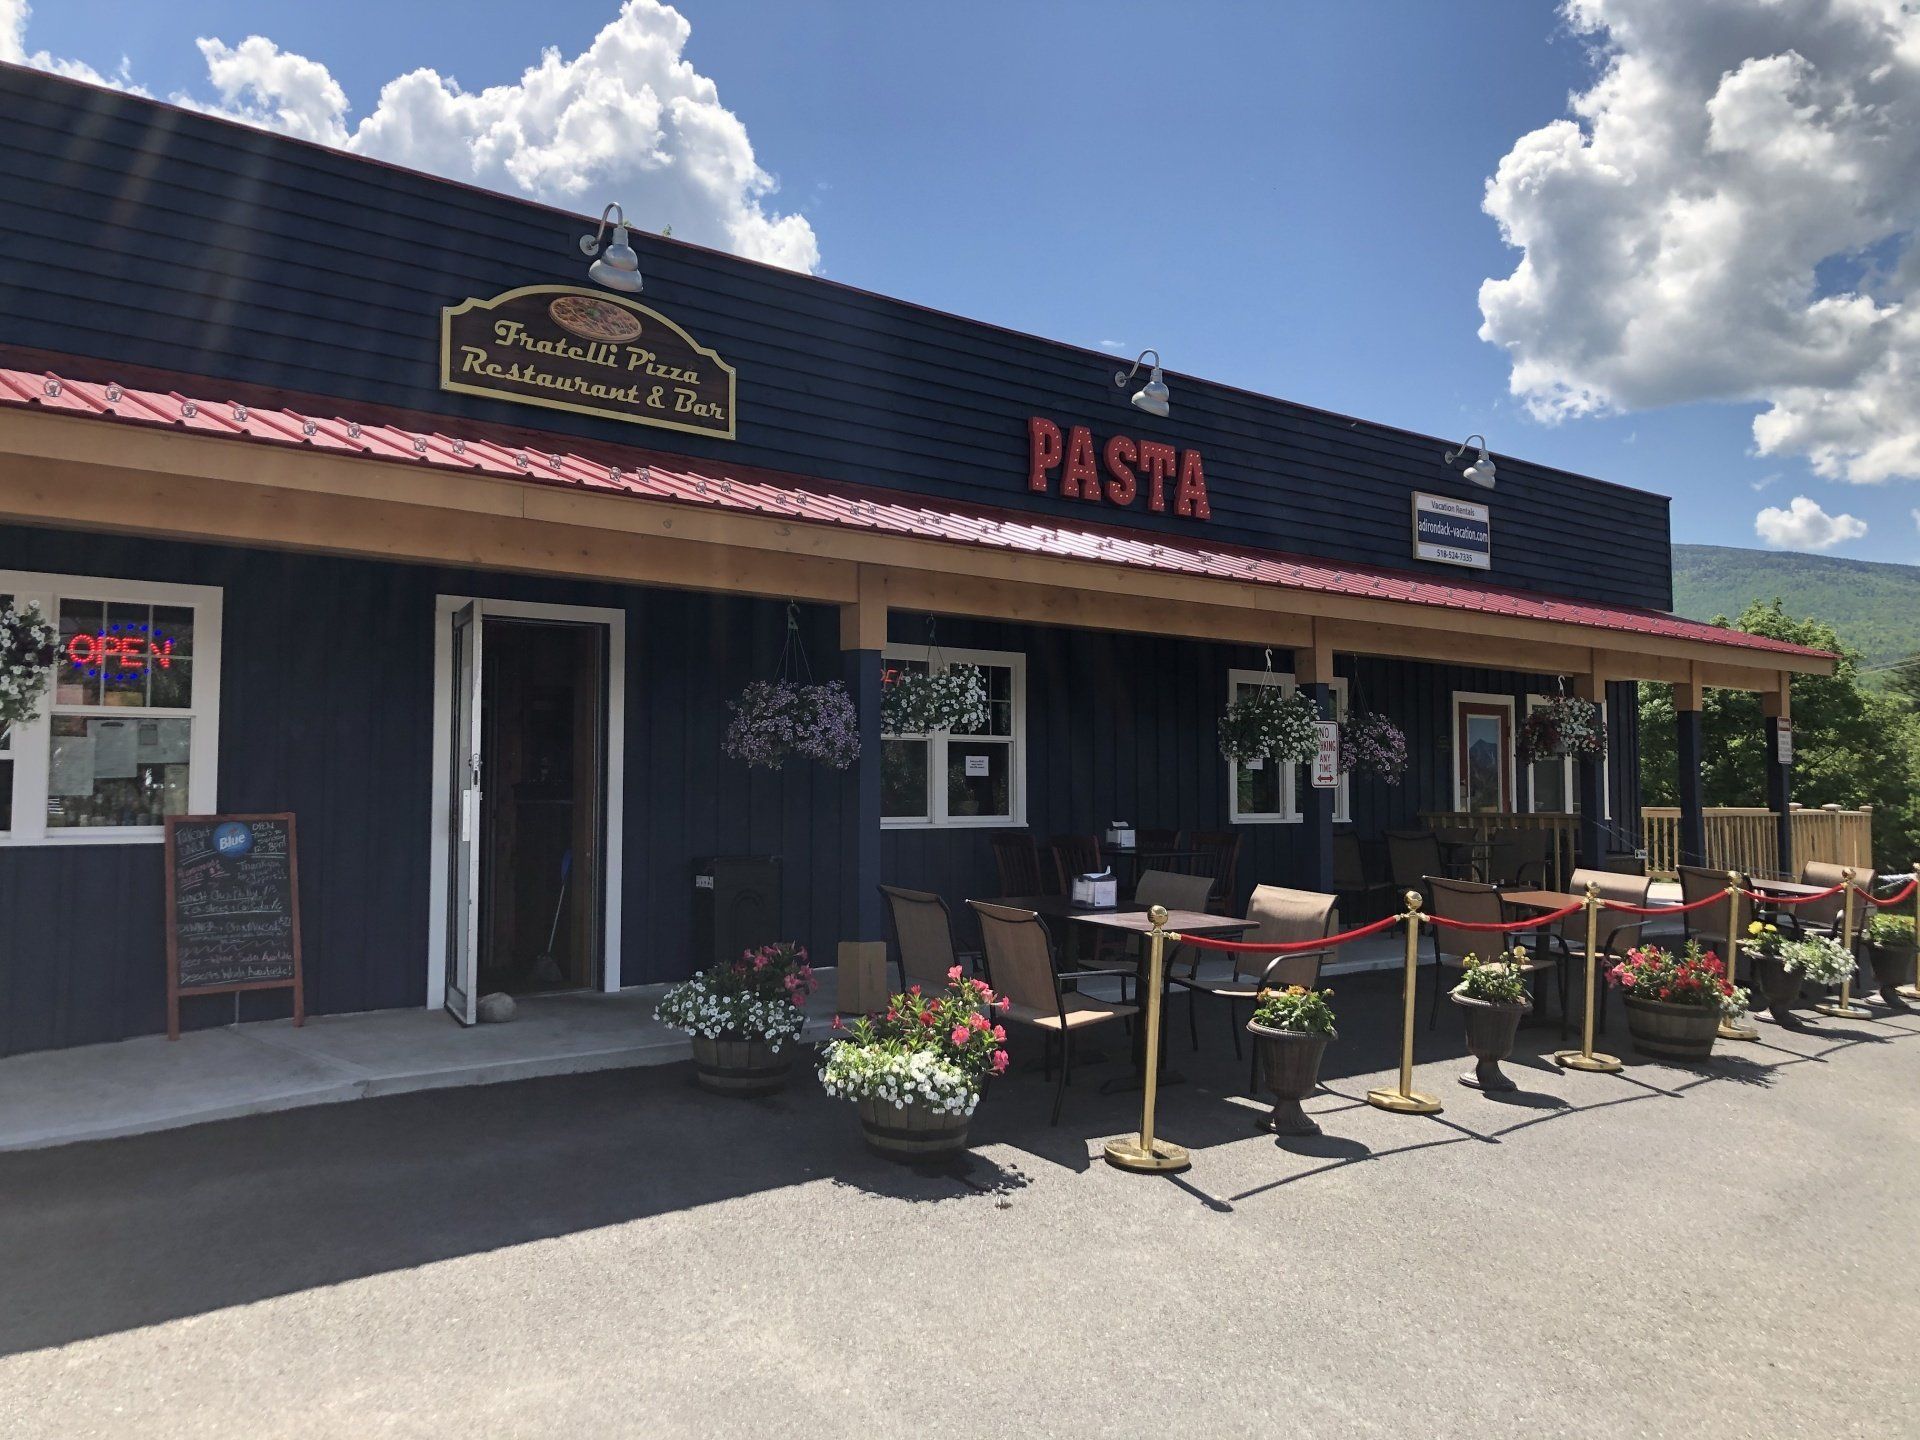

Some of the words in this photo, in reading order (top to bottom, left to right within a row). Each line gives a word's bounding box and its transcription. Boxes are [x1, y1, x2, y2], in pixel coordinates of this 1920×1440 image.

[494, 319, 619, 368] Fratelli
[626, 346, 701, 385] Pizza
[460, 346, 641, 404] Restaurant
[646, 385, 665, 409] &
[673, 387, 725, 420] Bar
[1028, 416, 1211, 520] PASTA
[1431, 500, 1455, 512] Vacation
[1455, 505, 1475, 516] Rentals
[1418, 518, 1488, 543] adirondack-vacation.com
[1319, 727, 1330, 739] NO
[1319, 754, 1331, 763] ANY
[1319, 763, 1332, 773] TIME
[219, 833, 246, 850] Blue
